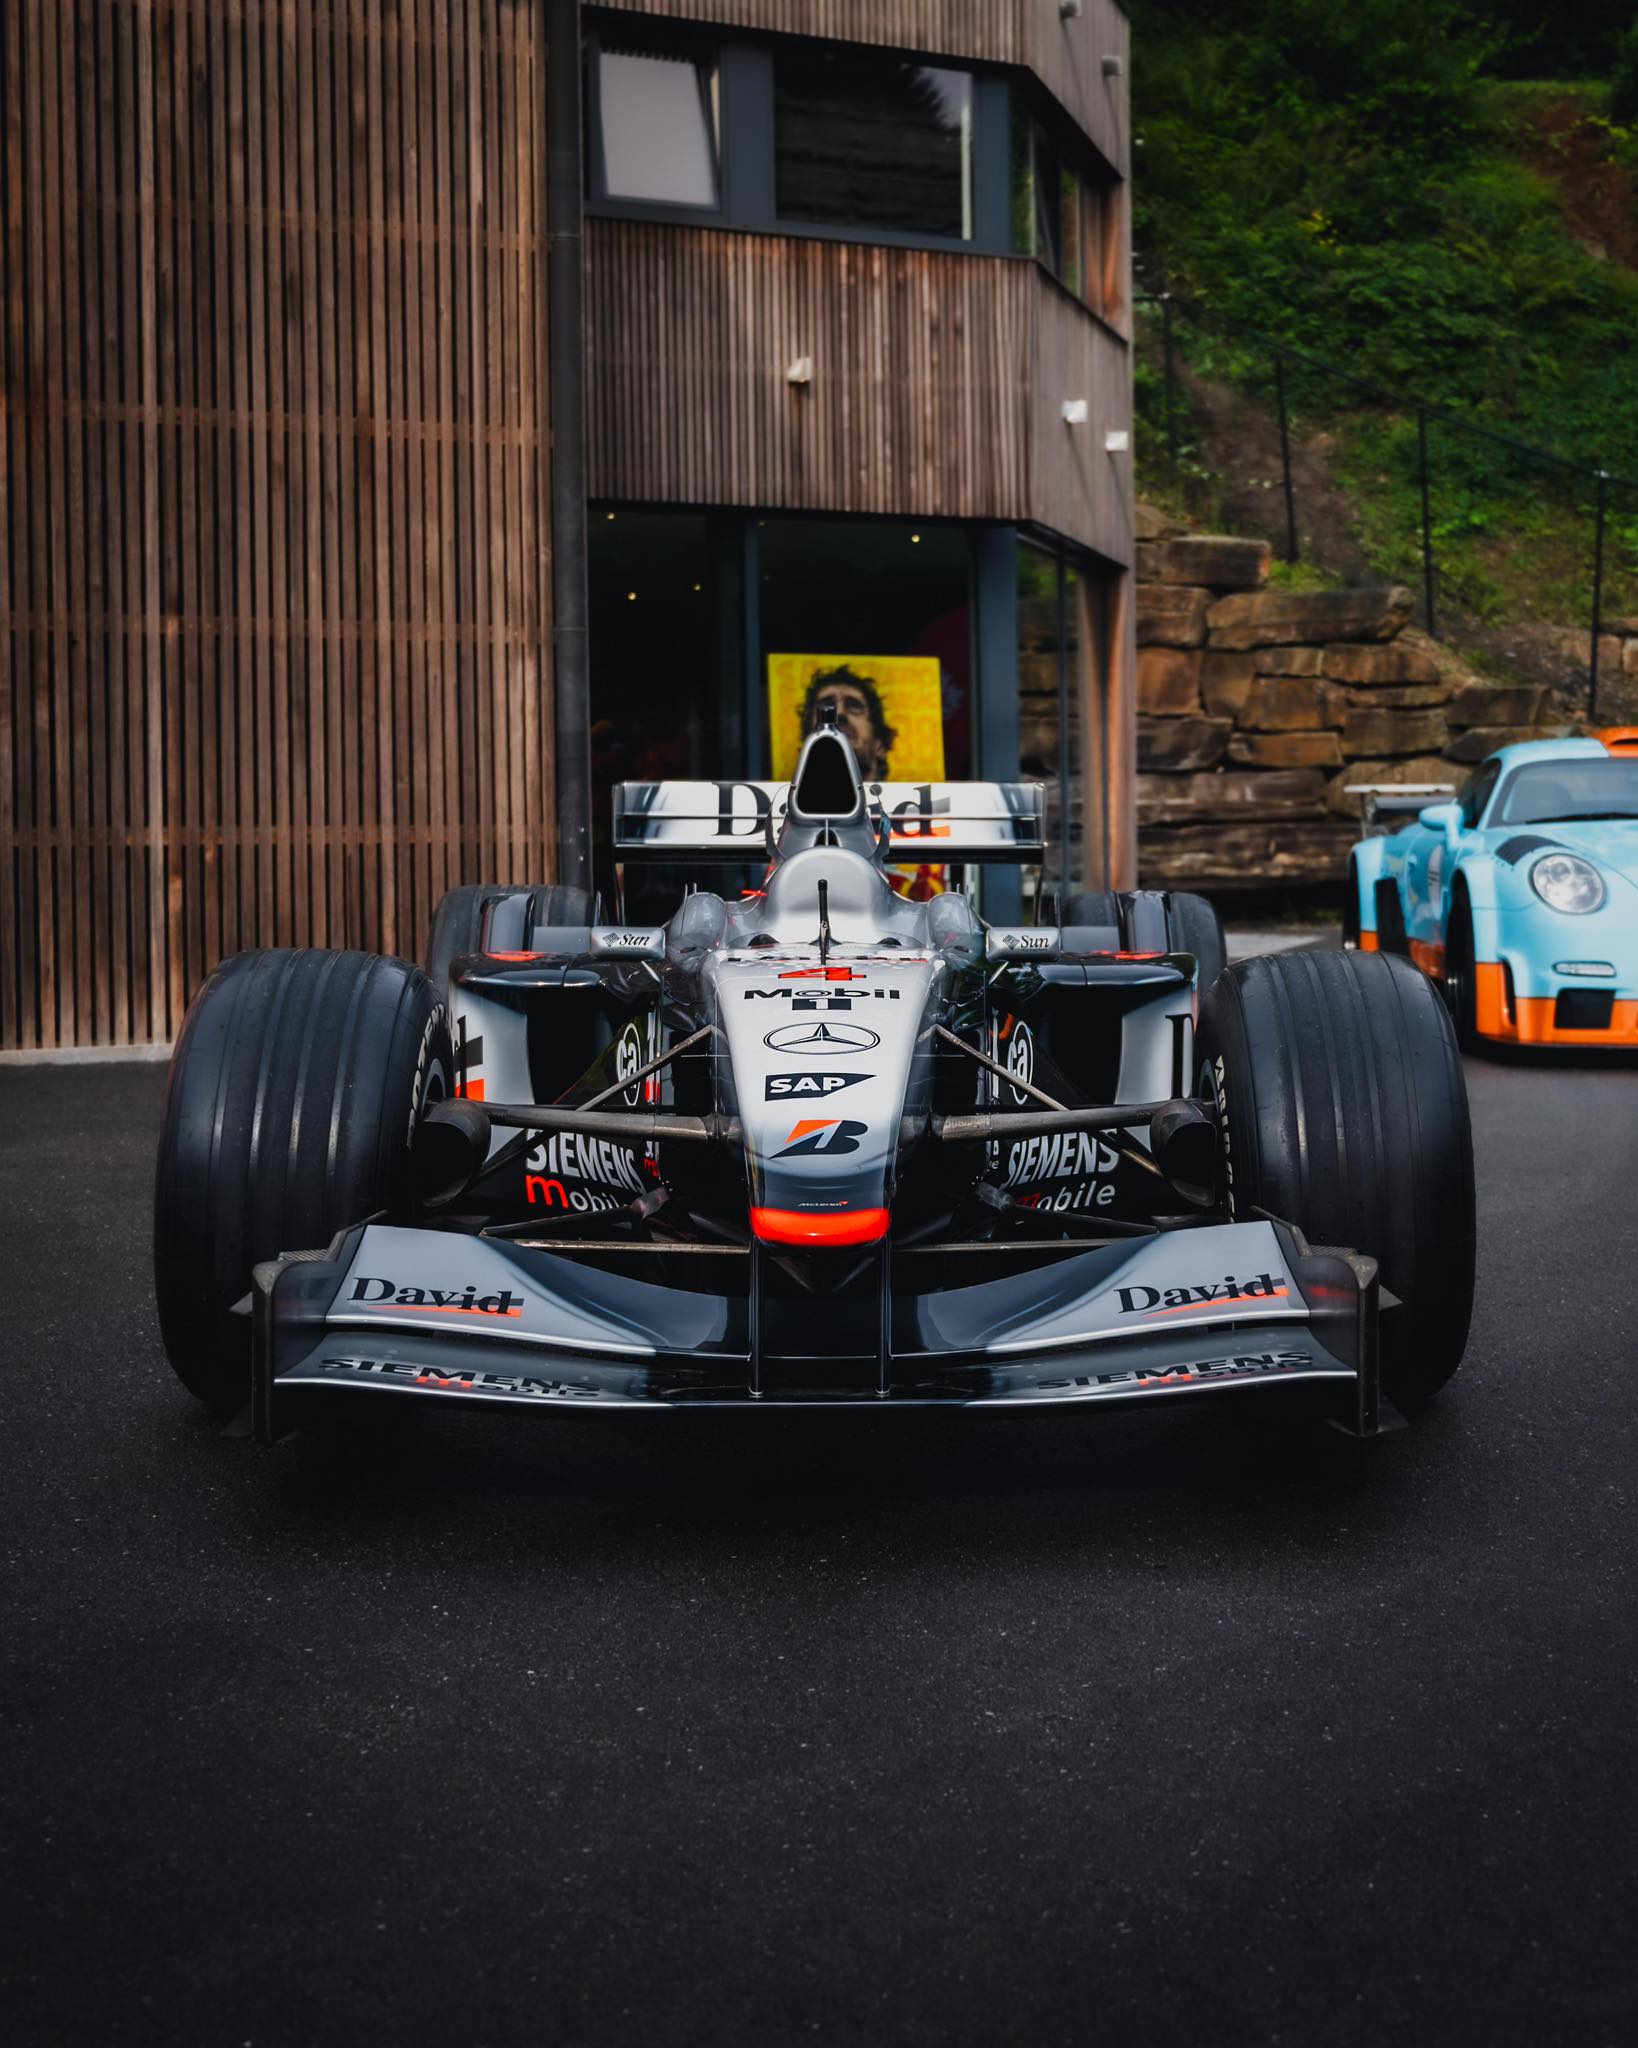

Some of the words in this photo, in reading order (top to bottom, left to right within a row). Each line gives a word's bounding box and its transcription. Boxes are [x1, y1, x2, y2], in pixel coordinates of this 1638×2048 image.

[711, 781, 933, 837] Did
[620, 933, 650, 945] Sun
[1020, 935, 1048, 948] Sun
[778, 967, 867, 981] 4
[744, 988, 900, 1000] Mobil
[769, 1076, 846, 1094] SAP
[525, 1174, 629, 1212] mobil
[347, 1276, 513, 1315] David
[1113, 1273, 1276, 1314] David
[319, 1358, 602, 1393] SIEMENS
[1038, 1351, 1314, 1390] SIEMENS
